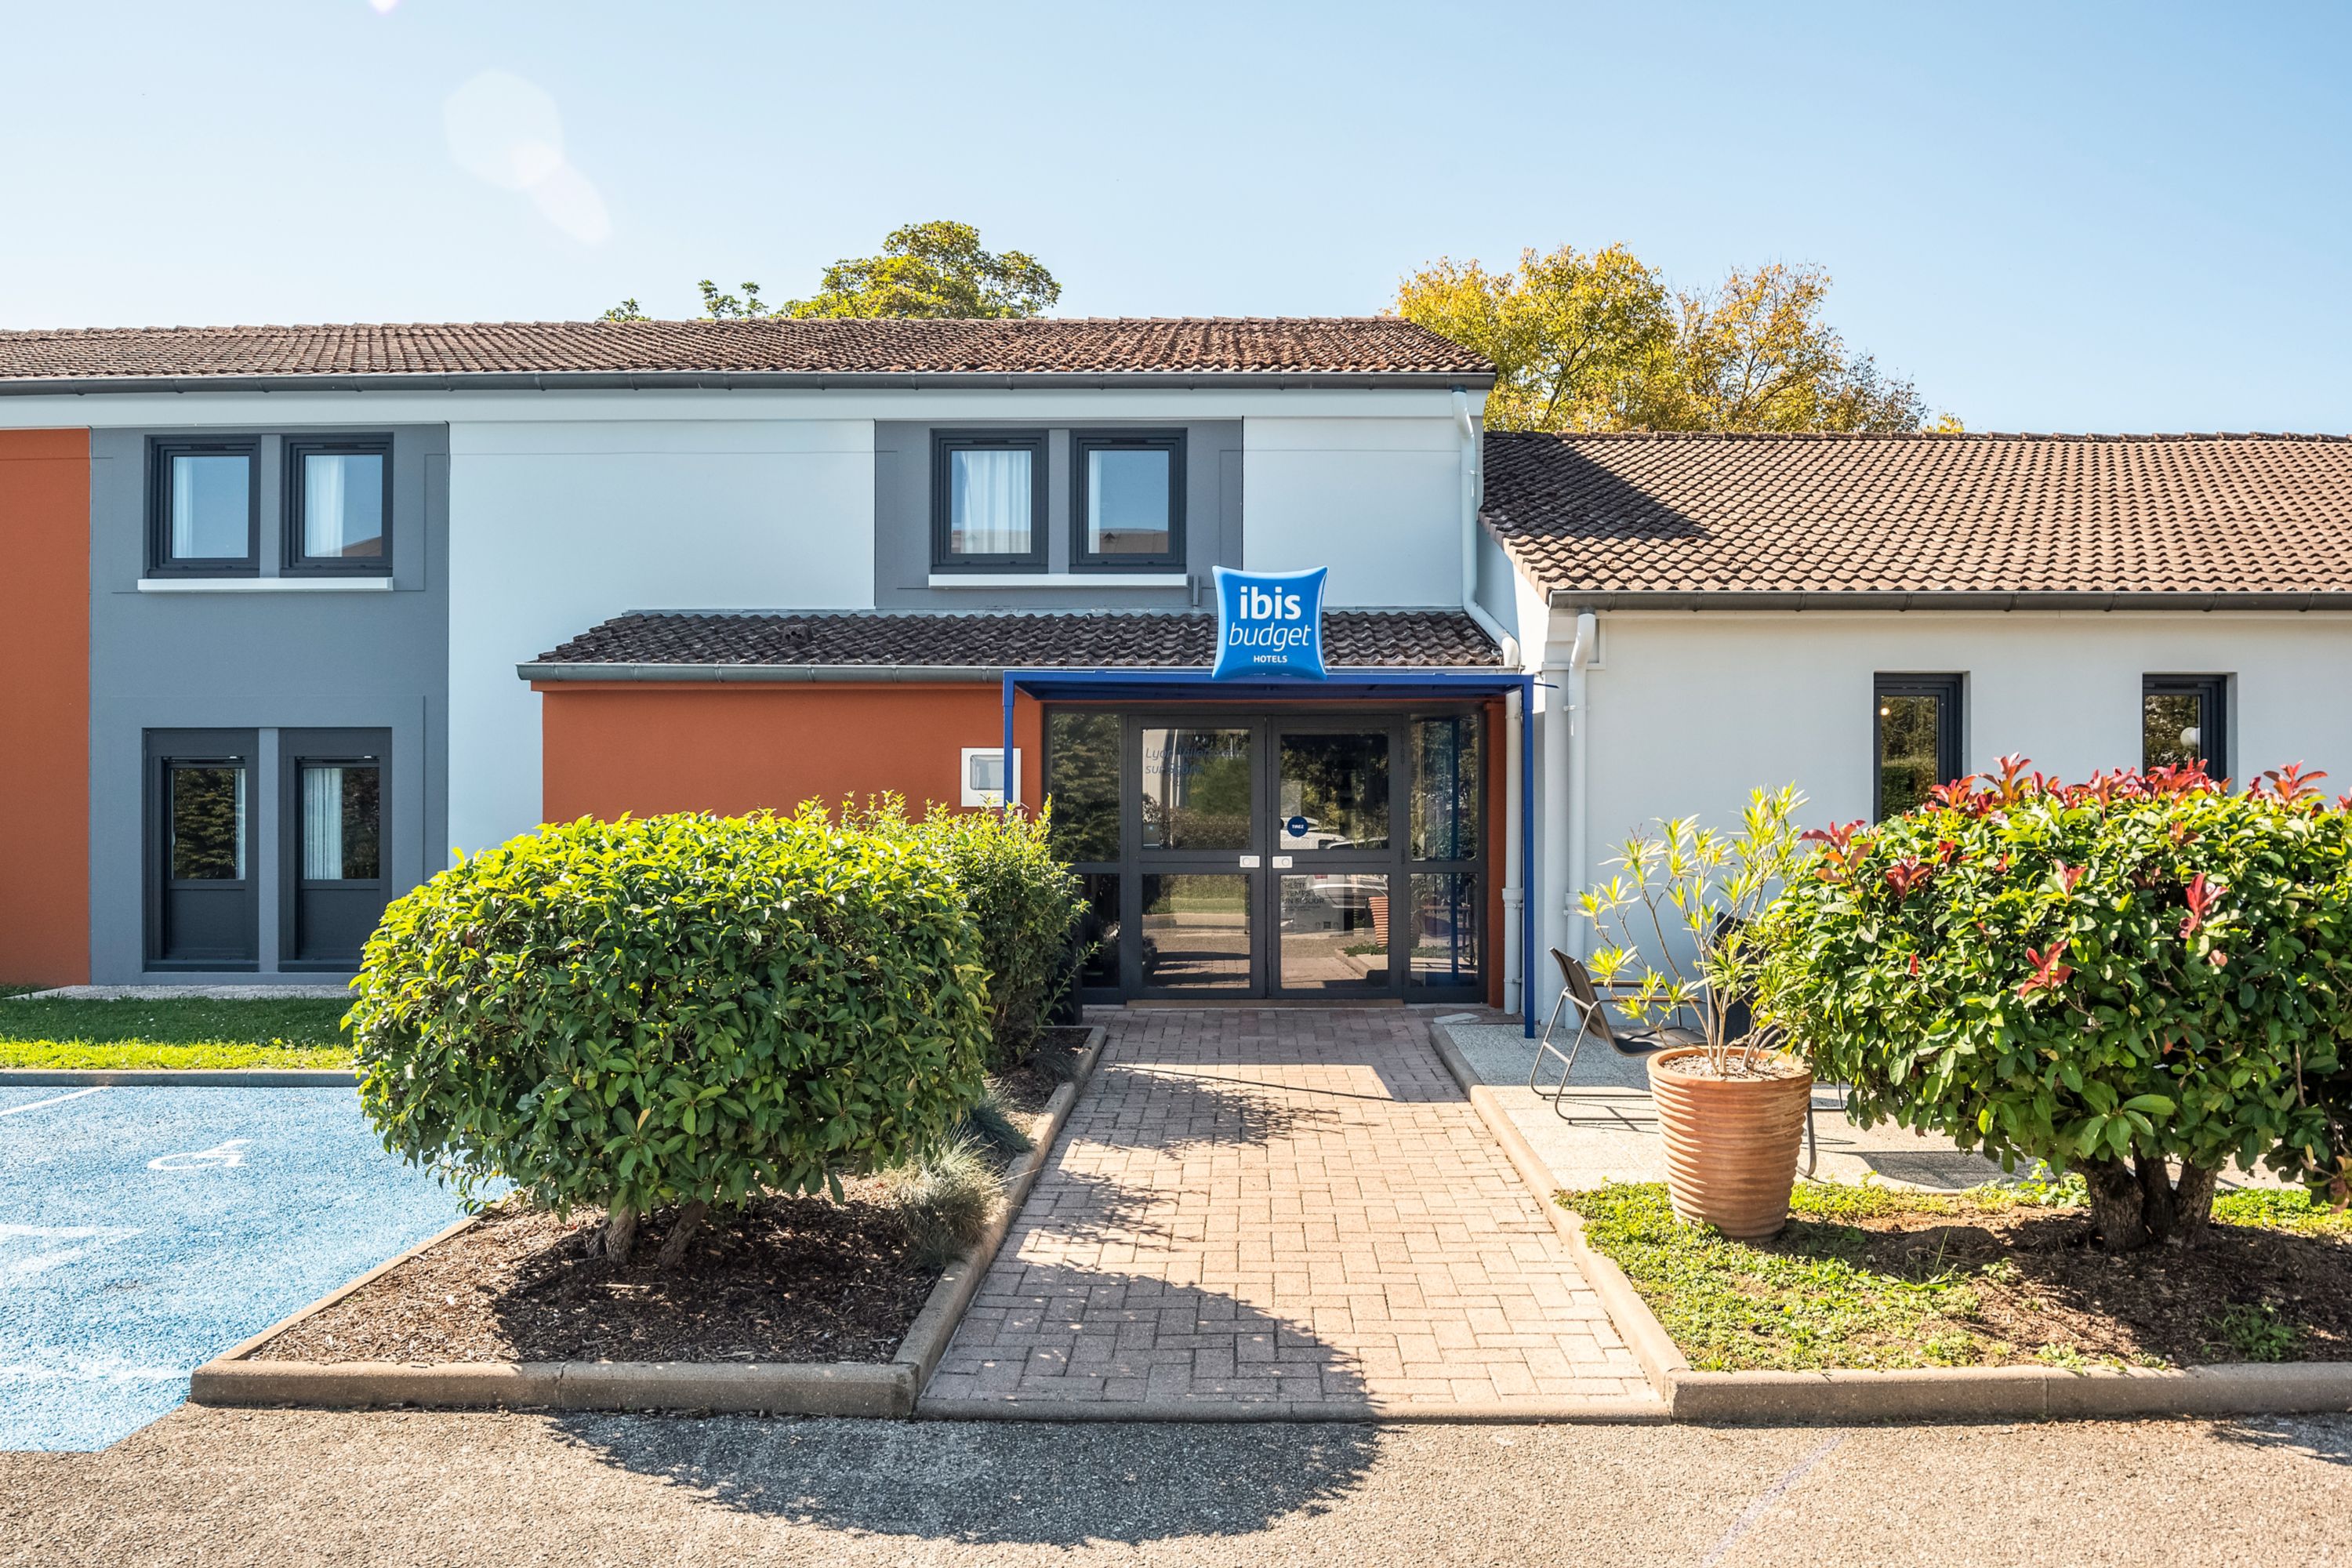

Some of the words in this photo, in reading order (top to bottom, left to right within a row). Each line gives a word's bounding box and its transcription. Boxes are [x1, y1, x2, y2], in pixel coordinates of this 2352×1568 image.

[1240, 586, 1301, 620] ibis
[1228, 622, 1312, 652] budget
[1253, 655, 1288, 663] HOTELS
[1145, 746, 1174, 761] Lyon
